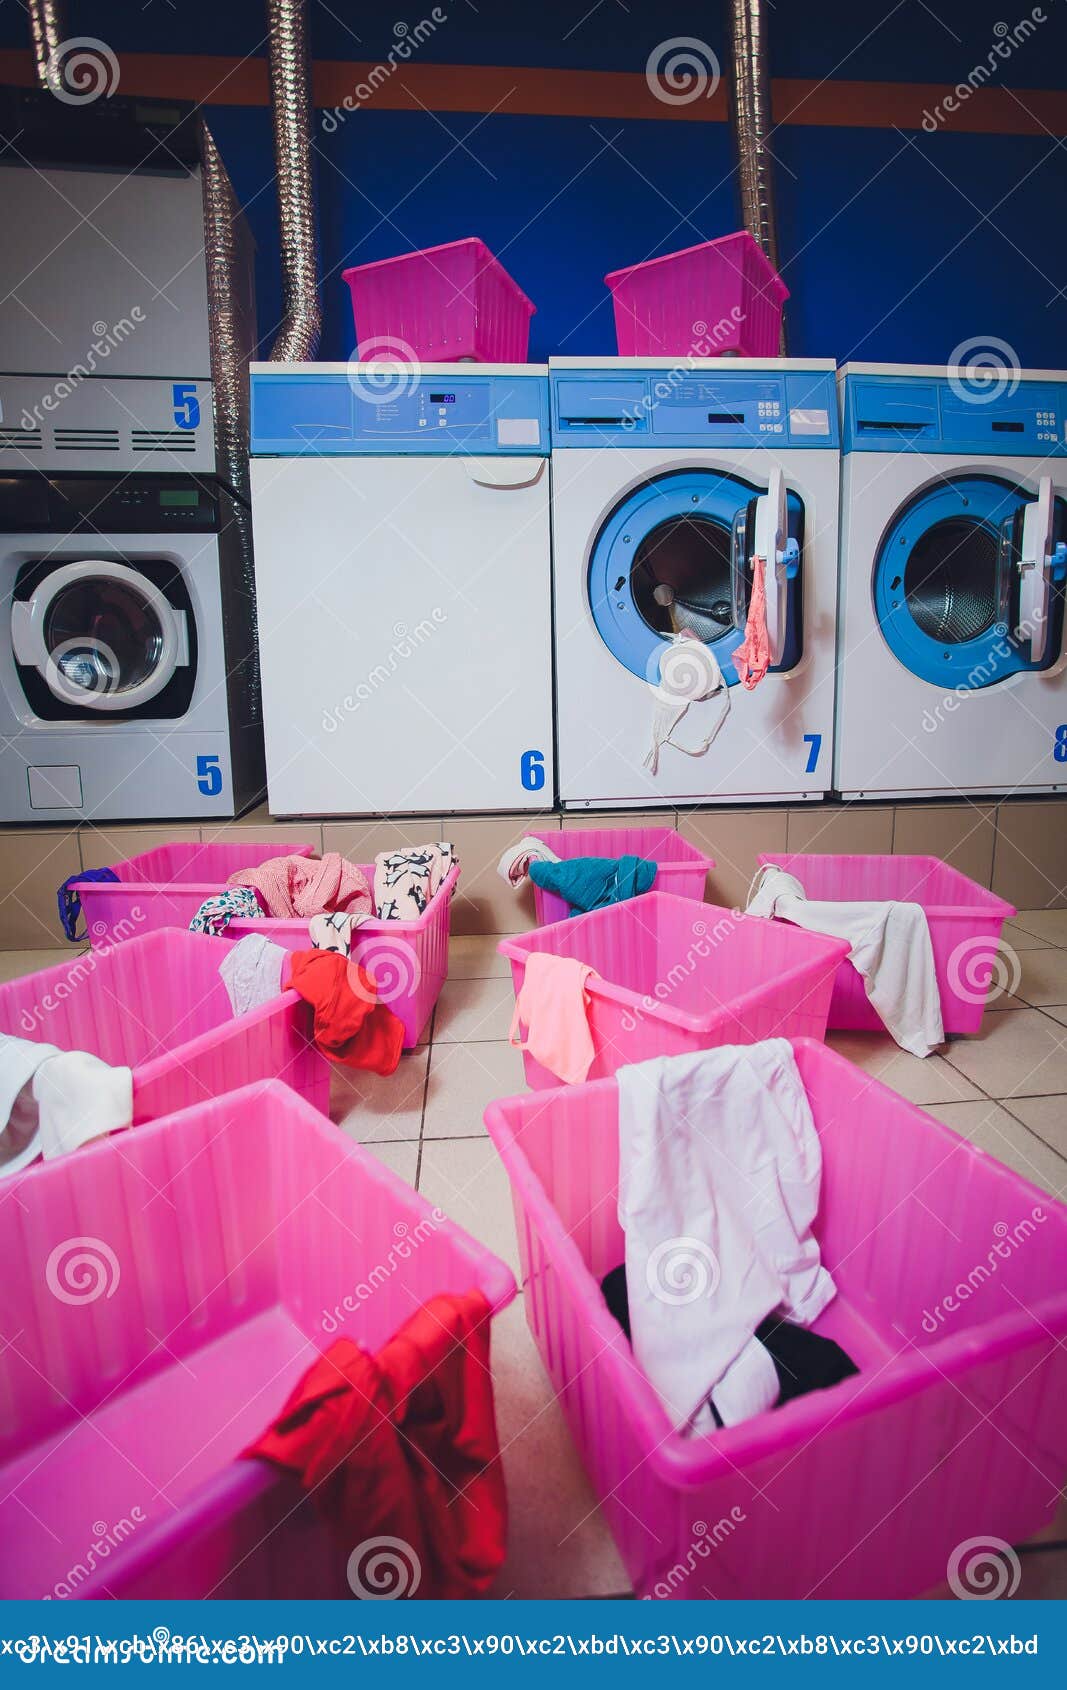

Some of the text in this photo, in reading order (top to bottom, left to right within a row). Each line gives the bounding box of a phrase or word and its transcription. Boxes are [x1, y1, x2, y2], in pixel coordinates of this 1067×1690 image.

[173, 384, 200, 429] 5
[521, 751, 544, 790] 6
[804, 735, 821, 772] 7
[197, 756, 222, 796] 5
